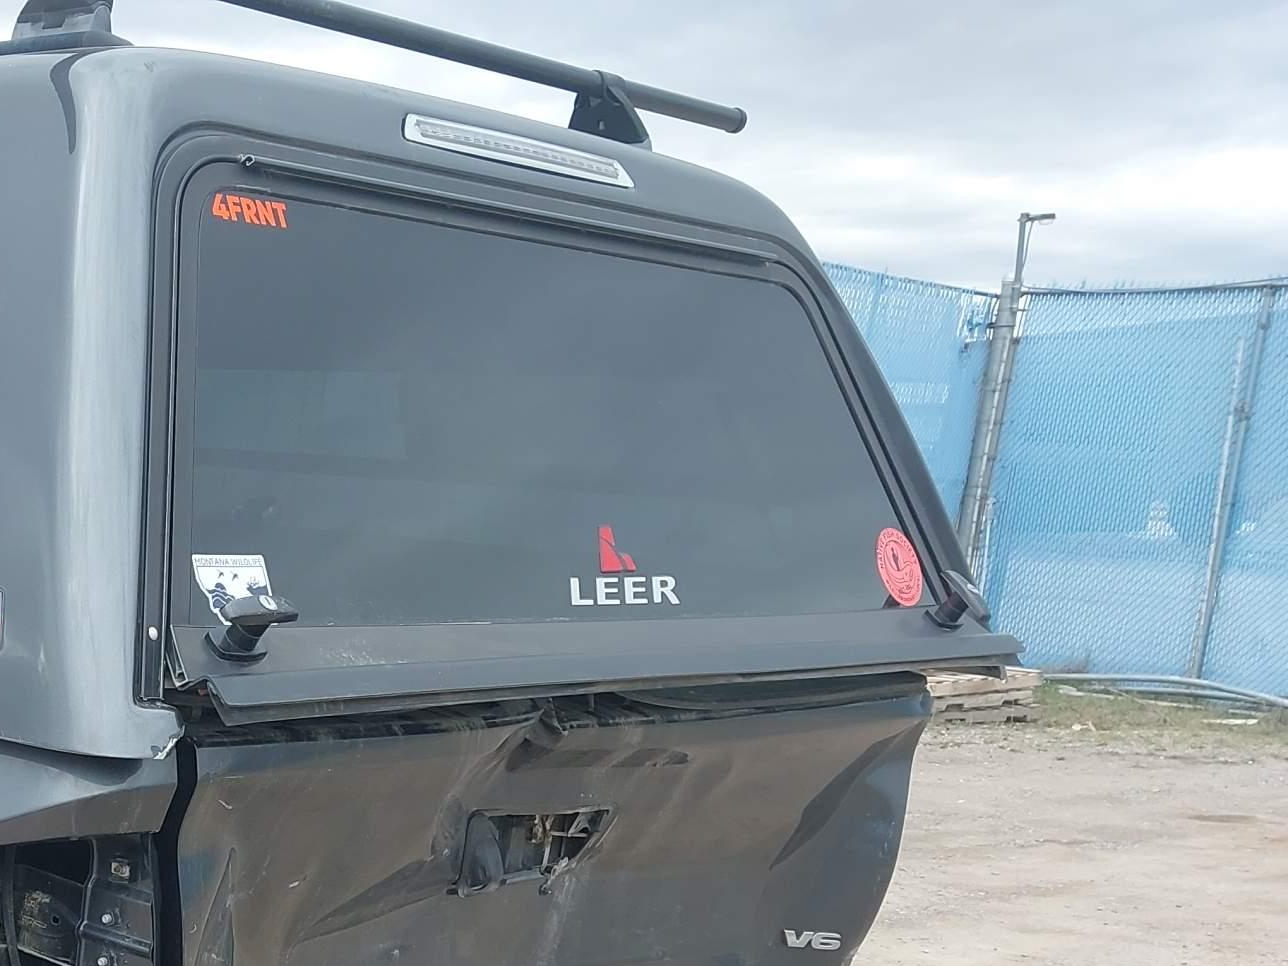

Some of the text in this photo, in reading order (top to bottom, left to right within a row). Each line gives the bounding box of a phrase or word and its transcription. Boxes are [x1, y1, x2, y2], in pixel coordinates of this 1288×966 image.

[212, 193, 287, 229] 4FRNT
[570, 575, 681, 606] LEER
[784, 929, 842, 951] V6
